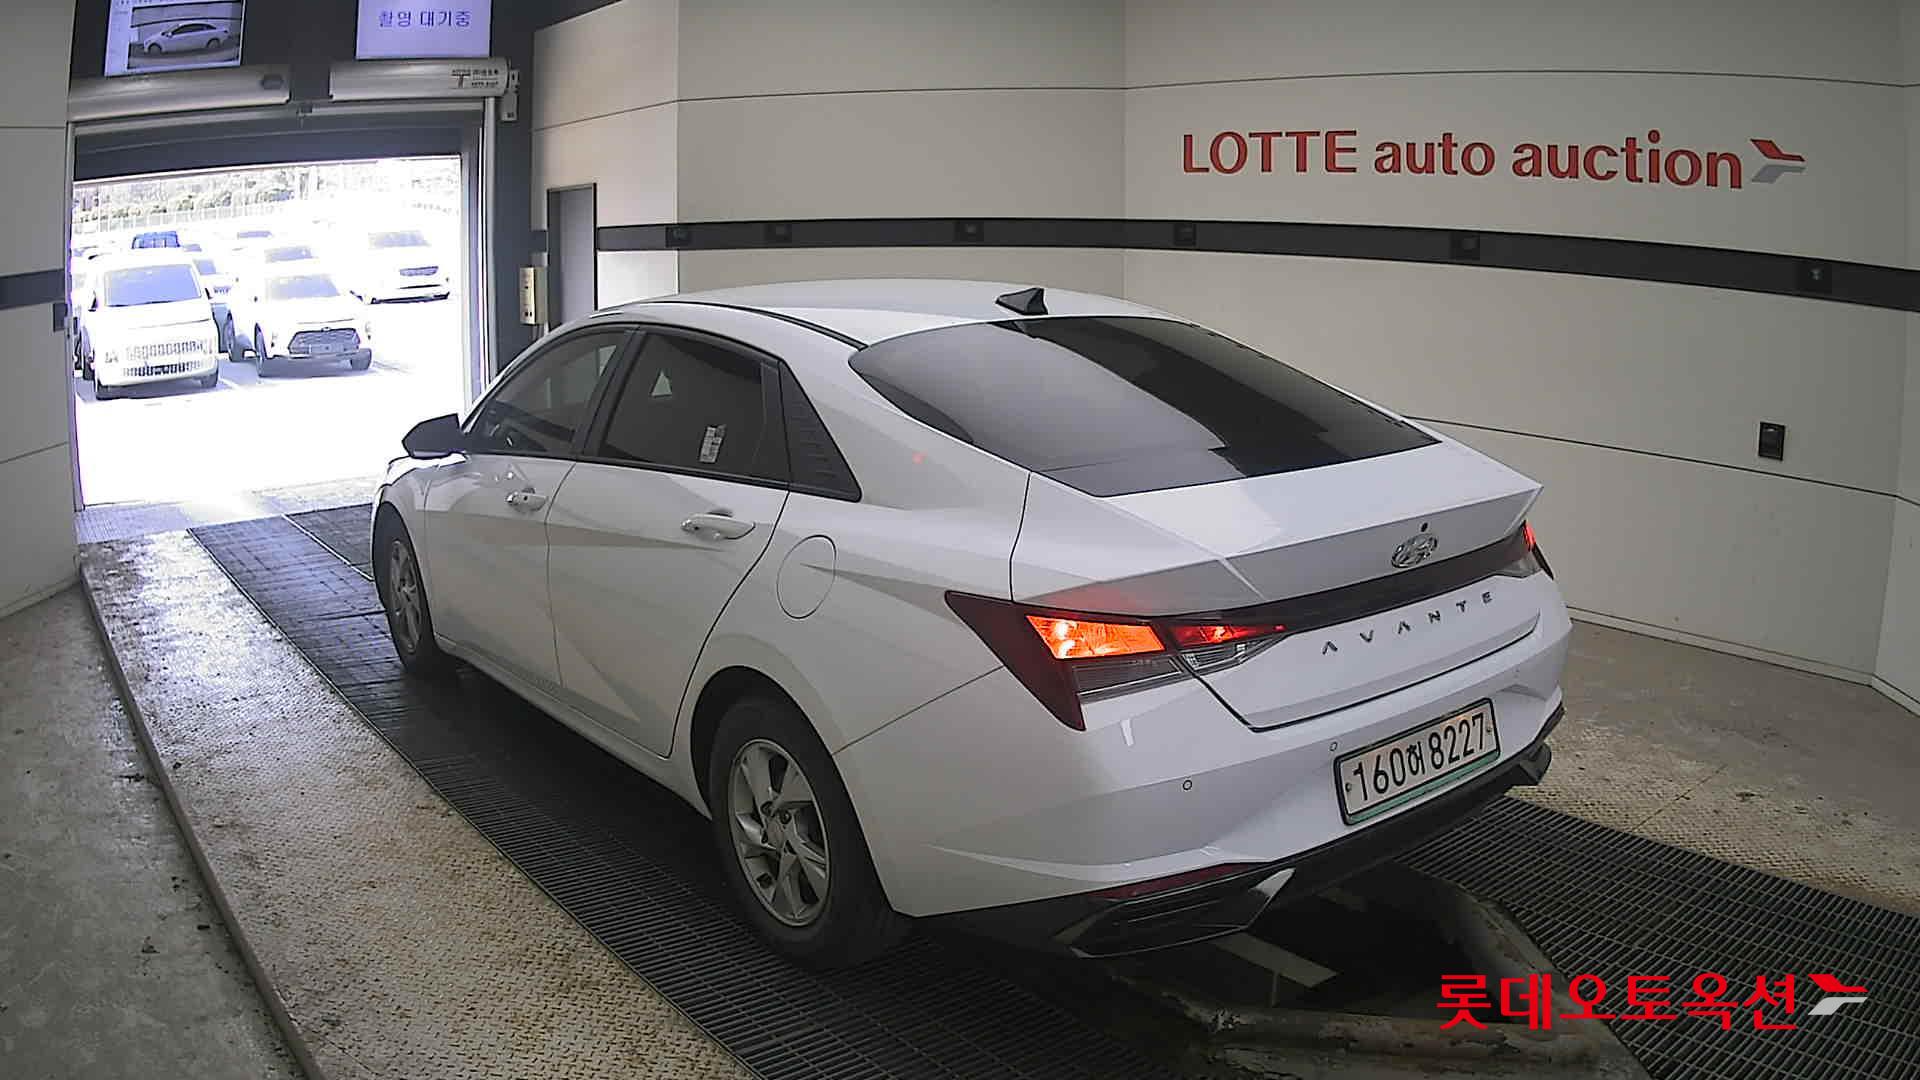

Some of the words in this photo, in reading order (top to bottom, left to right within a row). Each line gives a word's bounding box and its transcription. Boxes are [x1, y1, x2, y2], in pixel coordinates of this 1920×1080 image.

[419, 10, 471, 27] 대기중
[1183, 130, 1358, 174] LOTTE
[1374, 132, 1496, 176] auto
[1512, 129, 1744, 189] auction
[1322, 591, 1493, 655] AVANTE
